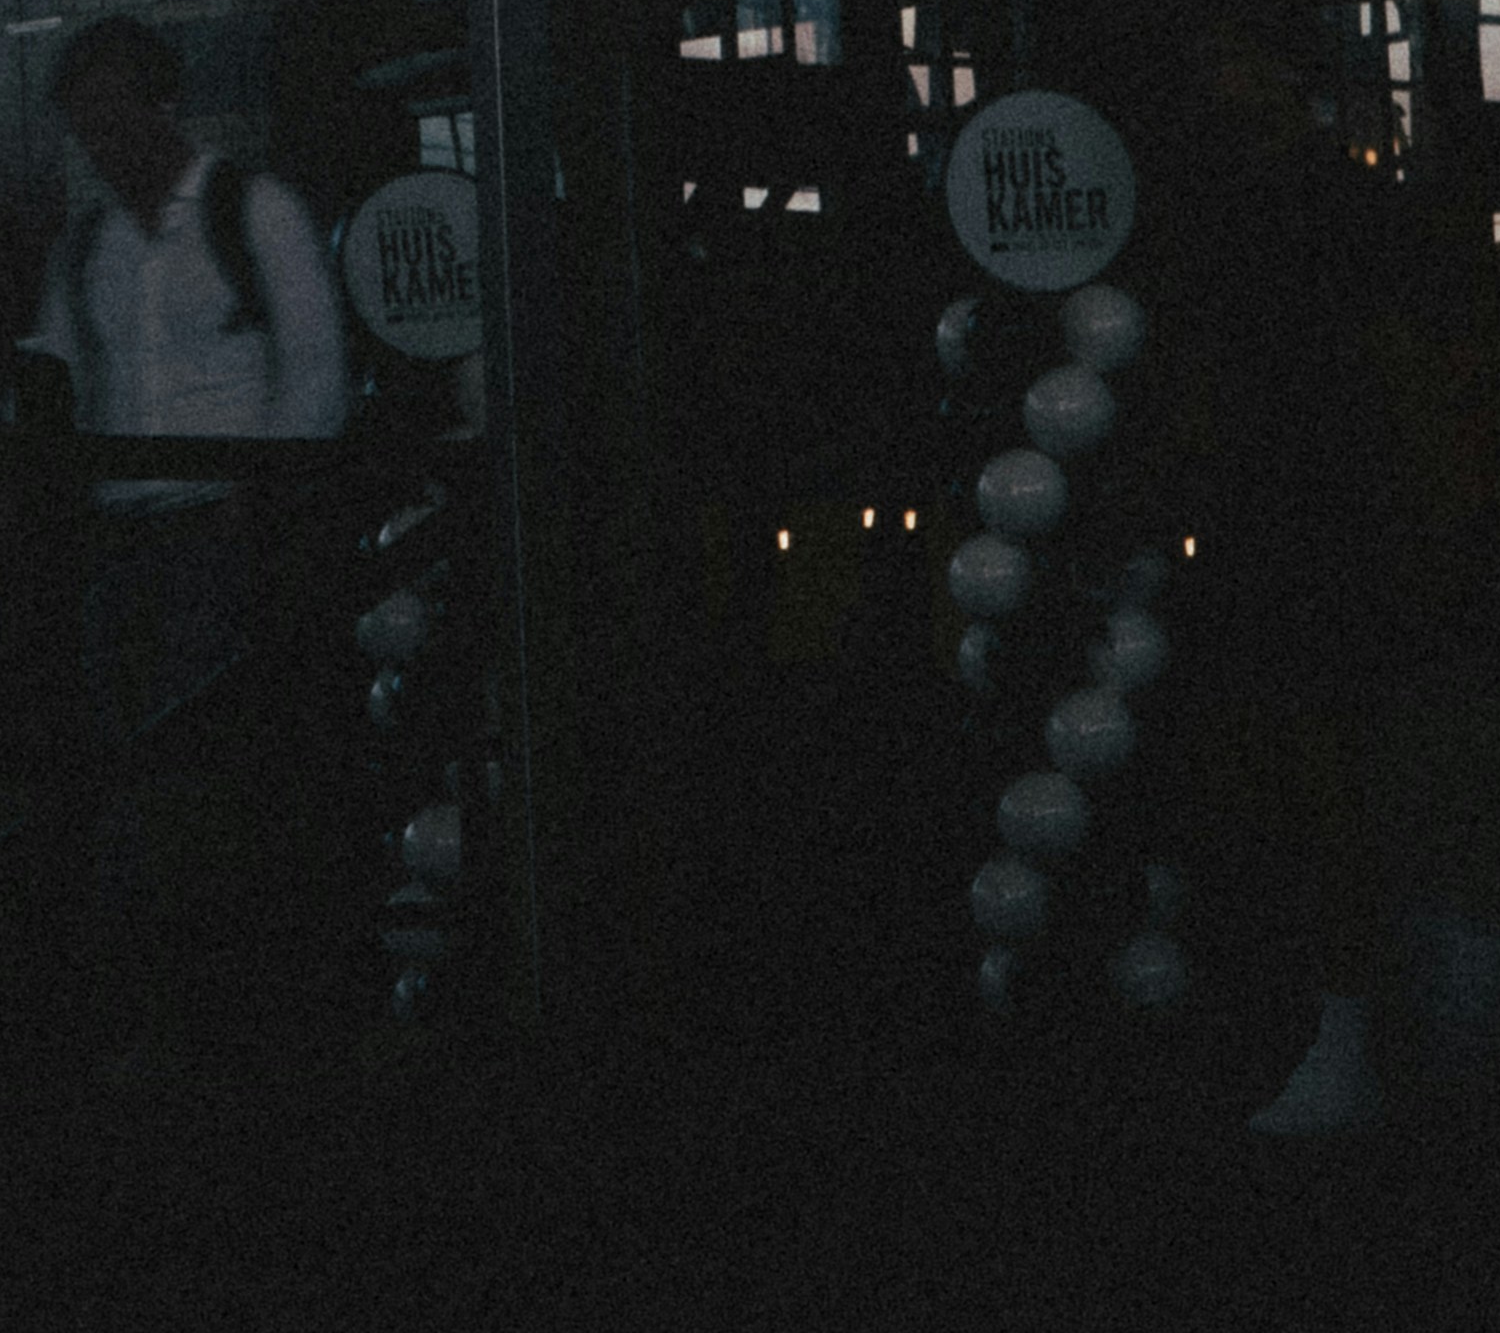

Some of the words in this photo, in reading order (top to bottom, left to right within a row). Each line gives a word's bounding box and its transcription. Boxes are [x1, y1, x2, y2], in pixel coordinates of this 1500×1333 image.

[982, 146, 1067, 191] HUIS
[986, 186, 1110, 233] KAMER
[378, 224, 457, 266] HUIS
[381, 262, 477, 306] KAME
